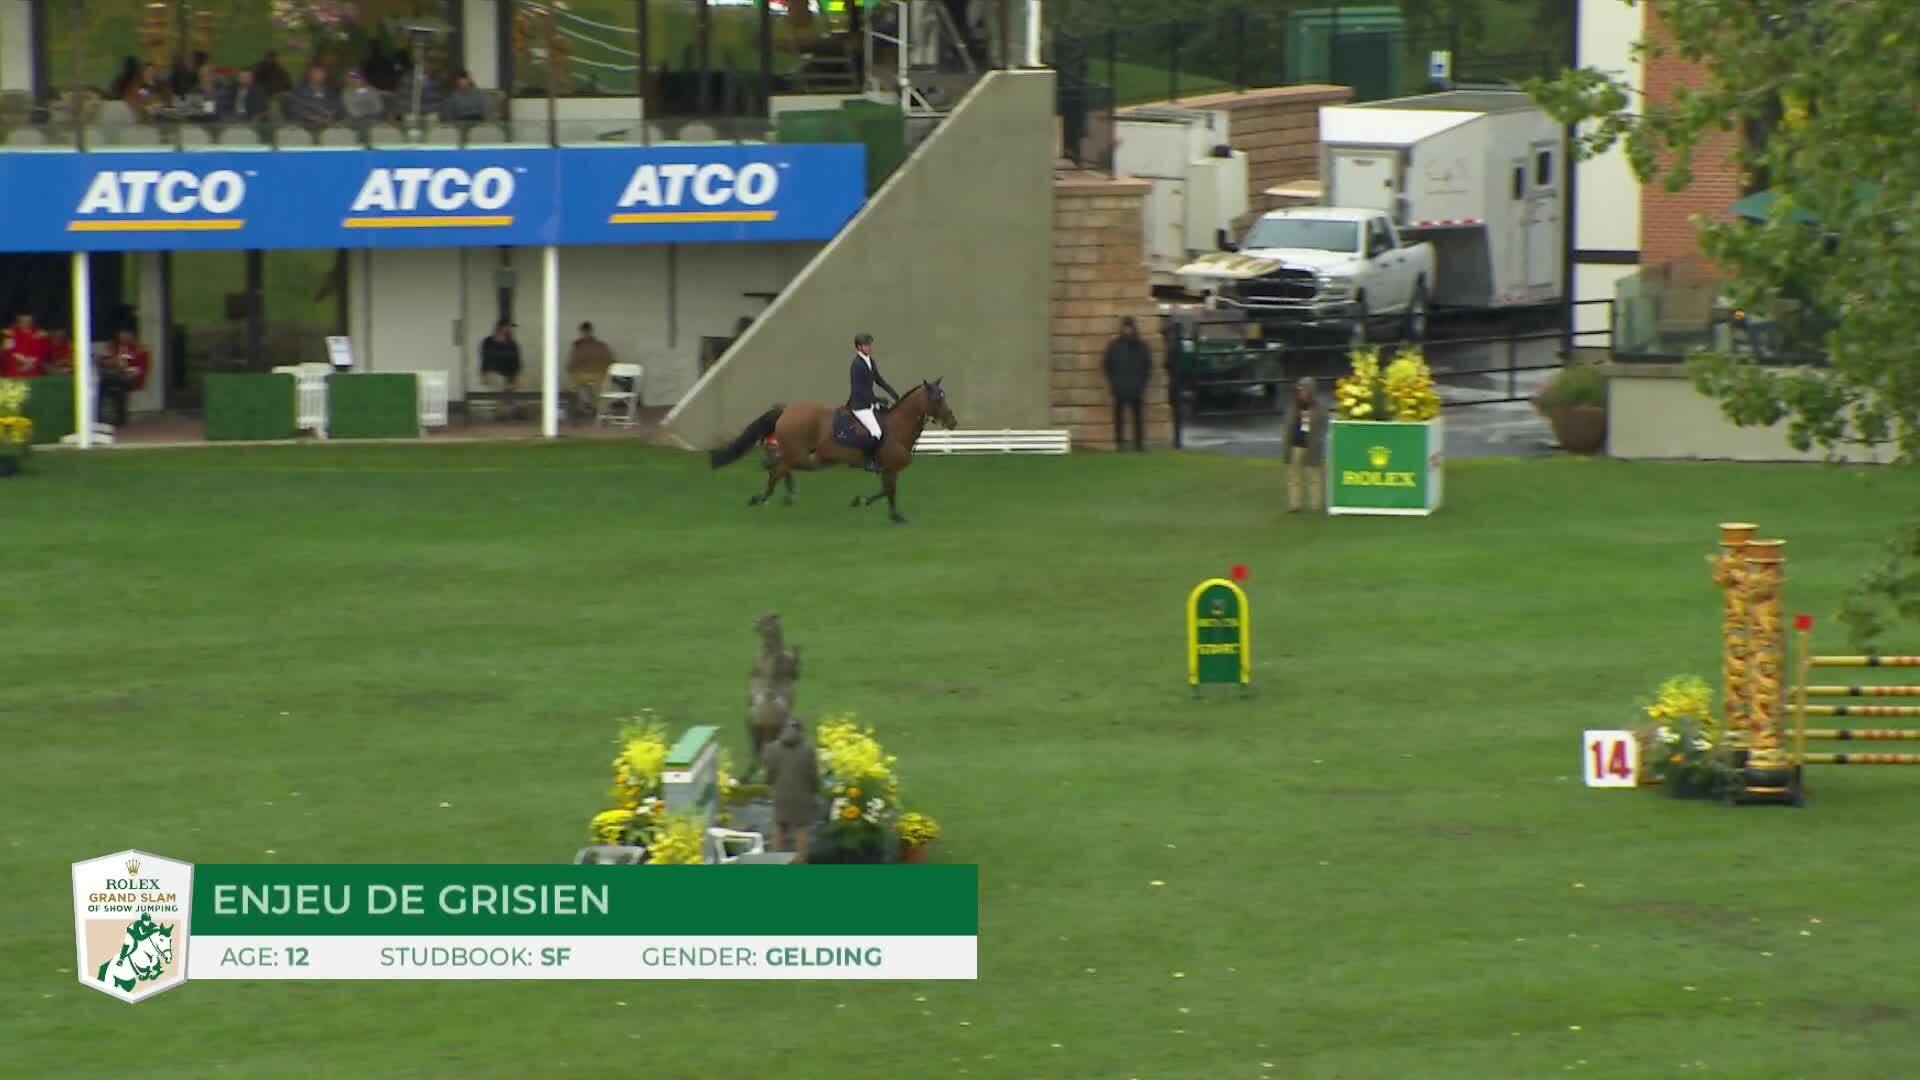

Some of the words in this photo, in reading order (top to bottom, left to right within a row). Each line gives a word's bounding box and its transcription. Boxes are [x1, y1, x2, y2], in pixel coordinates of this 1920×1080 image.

[75, 169, 247, 214] ATCO
[349, 167, 515, 212] ATCO
[616, 162, 779, 208] ATCO
[1341, 469, 1417, 488] ROLEX
[1590, 740, 1632, 779] 14
